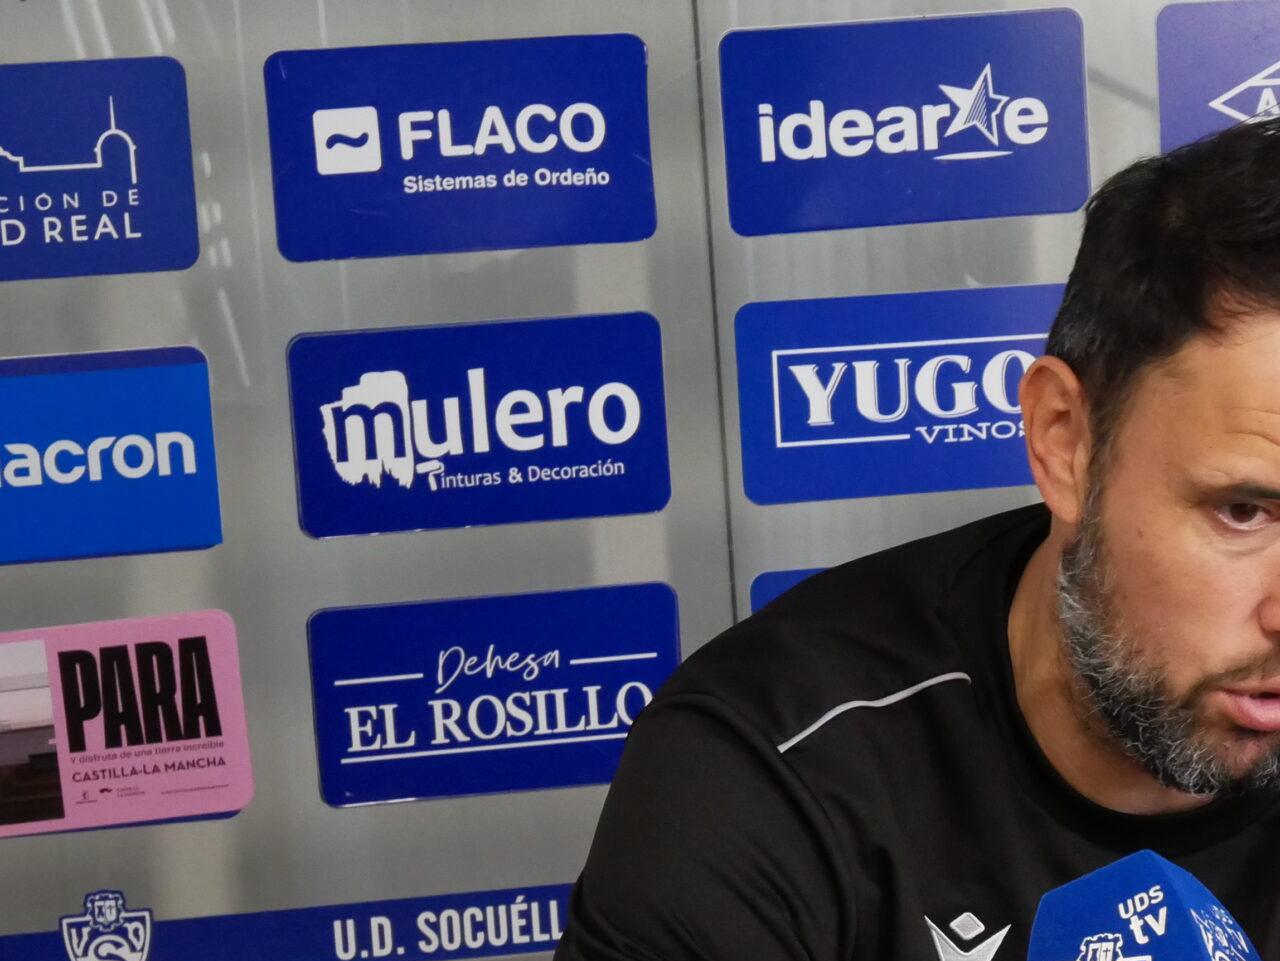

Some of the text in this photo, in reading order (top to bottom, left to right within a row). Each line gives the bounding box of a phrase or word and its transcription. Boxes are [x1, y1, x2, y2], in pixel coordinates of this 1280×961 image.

[398, 102, 606, 161] FLACO
[102, 188, 140, 207] DE
[403, 167, 610, 194] Sistemas de Ordeño
[43, 212, 142, 243] REAL
[788, 350, 1037, 427] YUGO
[0, 431, 197, 488] acron
[416, 458, 625, 491] Tinturas & Decoración
[435, 643, 560, 694] Dehesa
[57, 635, 223, 753] PARA
[344, 681, 653, 753] EL ROSILLO
[72, 756, 226, 783] CASTILLA-LA MANCHA
[79, 752, 118, 765] disfruta
[119, 751, 132, 759] de
[134, 748, 153, 758] una
[155, 745, 181, 755] tierra
[1117, 884, 1165, 920] UDS
[333, 915, 405, 961] U.D.
[1129, 905, 1168, 945] tv
